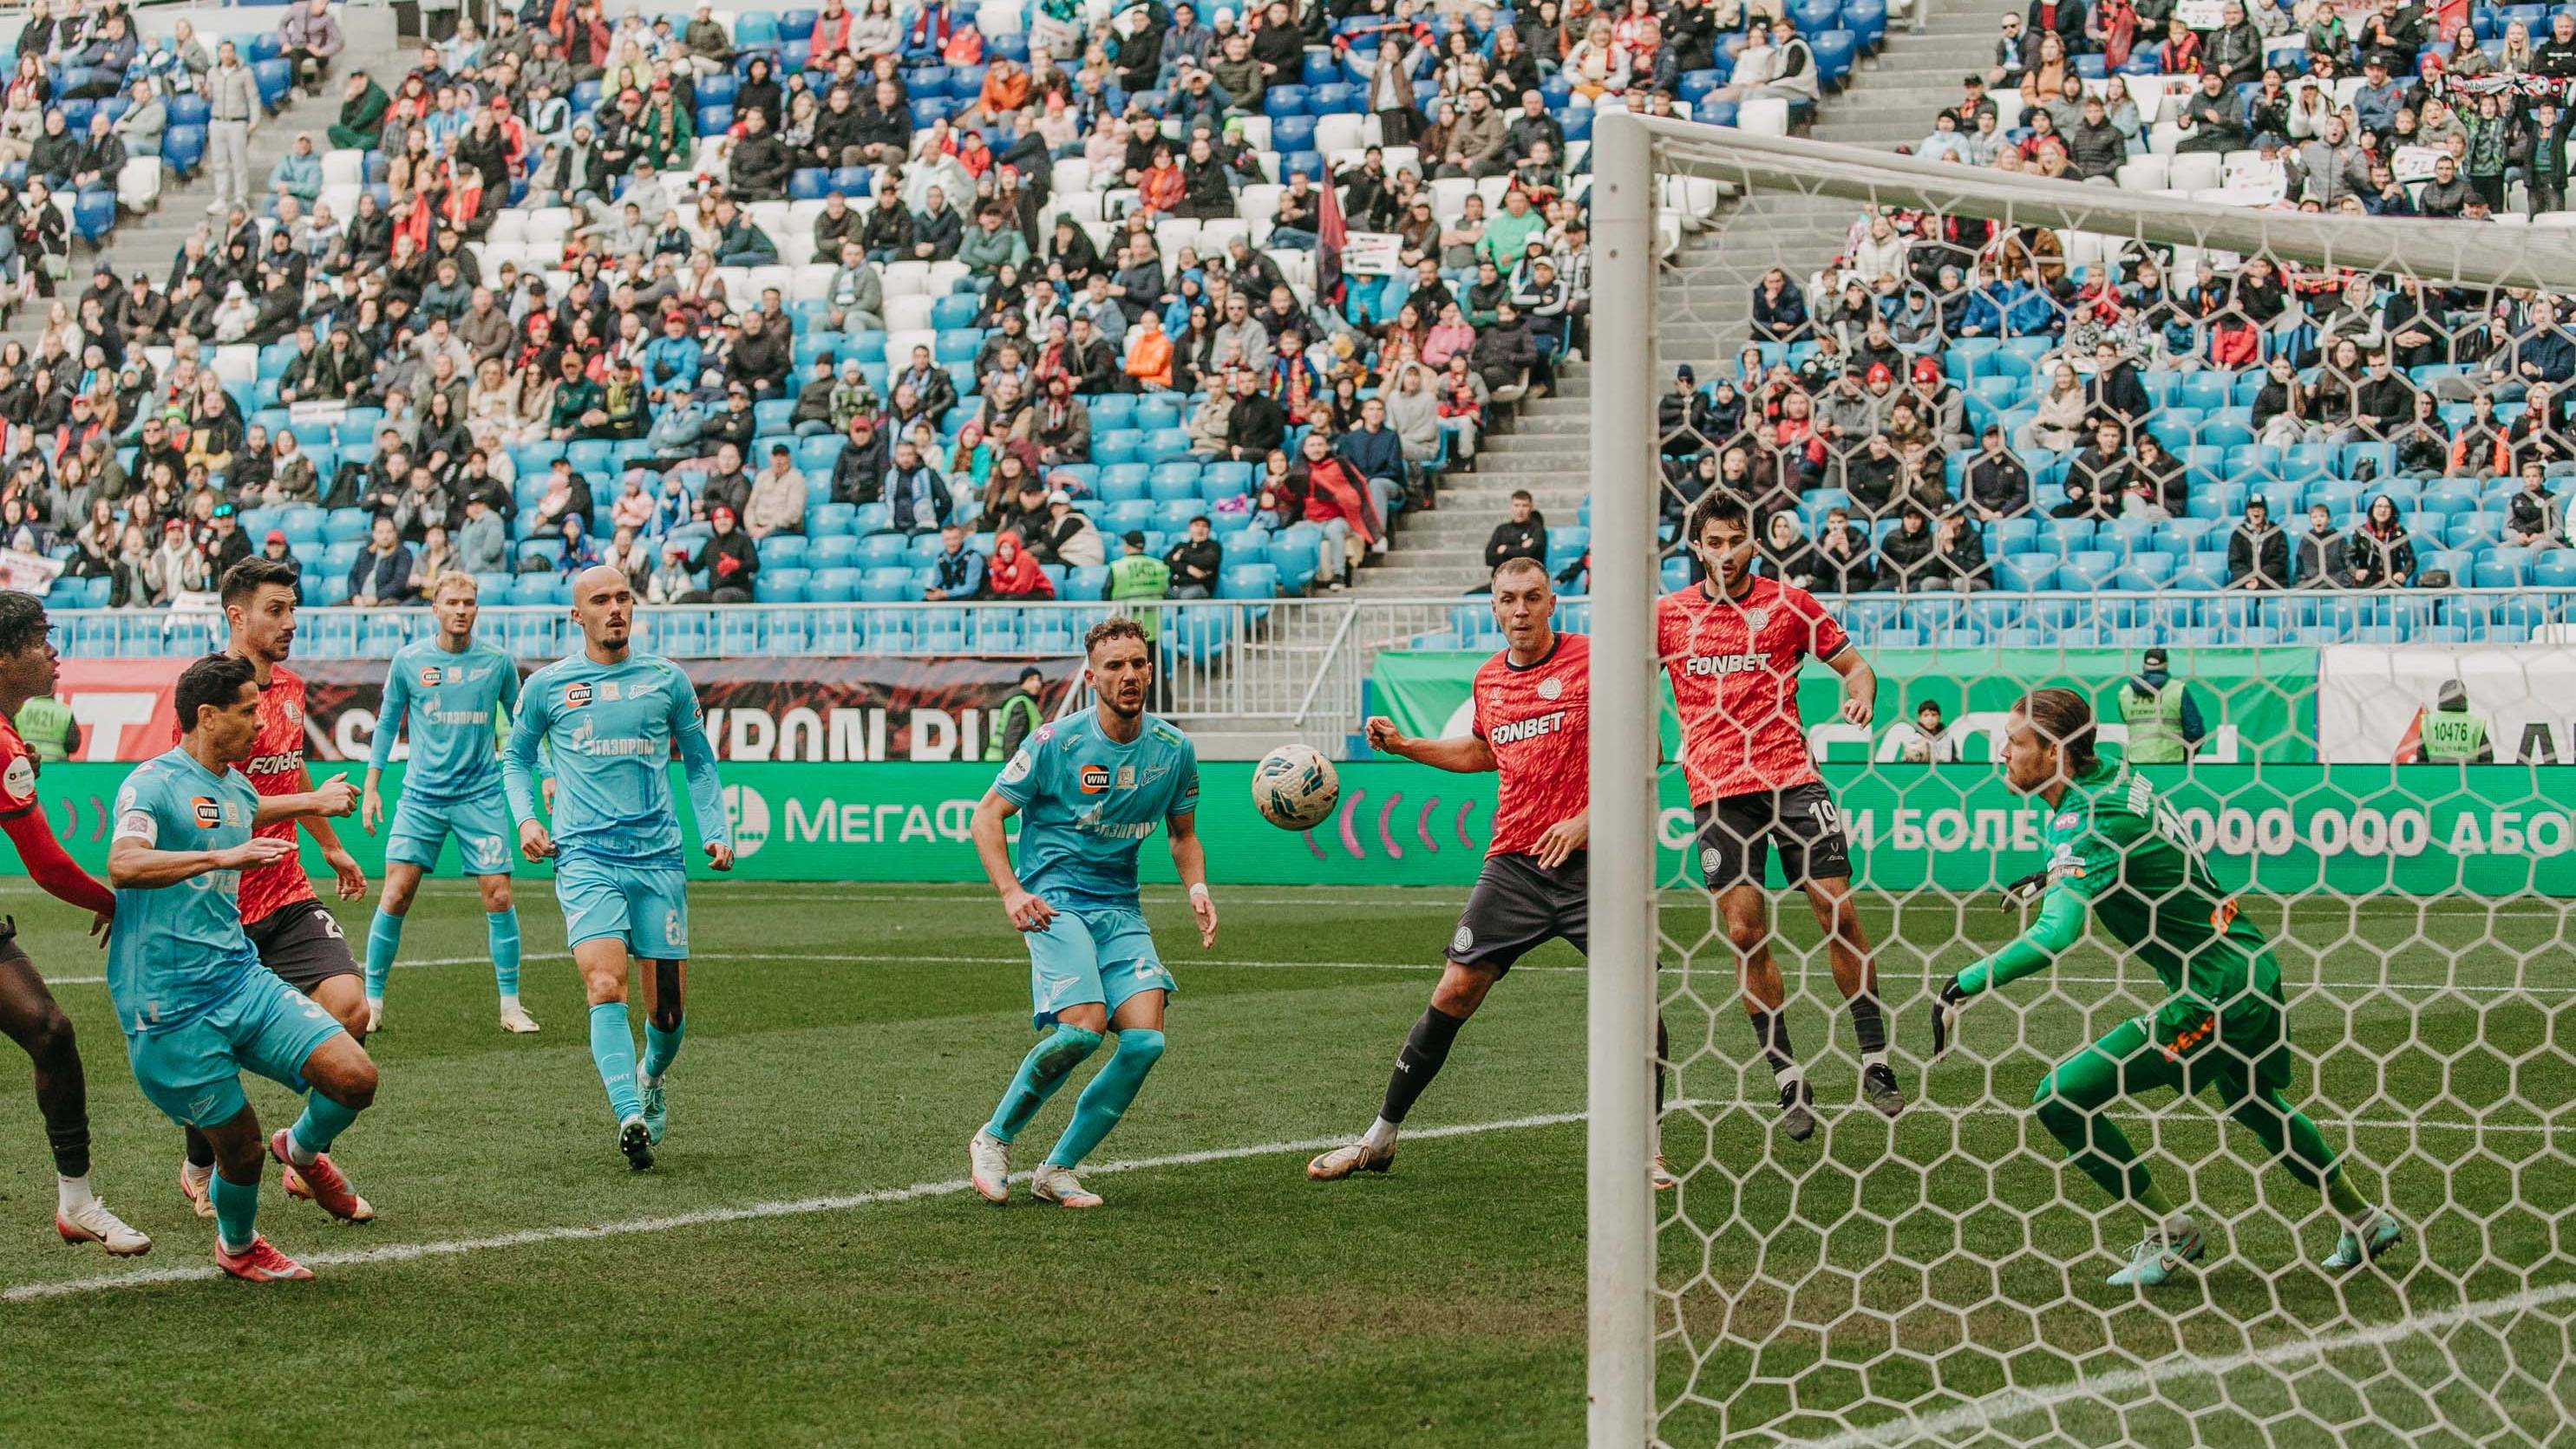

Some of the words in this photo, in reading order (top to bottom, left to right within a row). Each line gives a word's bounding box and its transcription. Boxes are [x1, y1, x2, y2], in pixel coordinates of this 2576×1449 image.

[1686, 653, 1772, 676] FONBET
[571, 689, 592, 699] WIN
[1492, 711, 1566, 744] FONBET
[2435, 723, 2468, 741] 10476
[594, 739, 655, 755] ГАЗПРОМ
[1087, 774, 1108, 785] WIN
[199, 807, 218, 818] WIN
[784, 797, 1021, 844] МЕГАФ
[1809, 800, 1840, 836] 19
[1893, 808, 2055, 853] БОЛЕ
[2310, 807, 2428, 857] 000
[474, 835, 504, 865] 32
